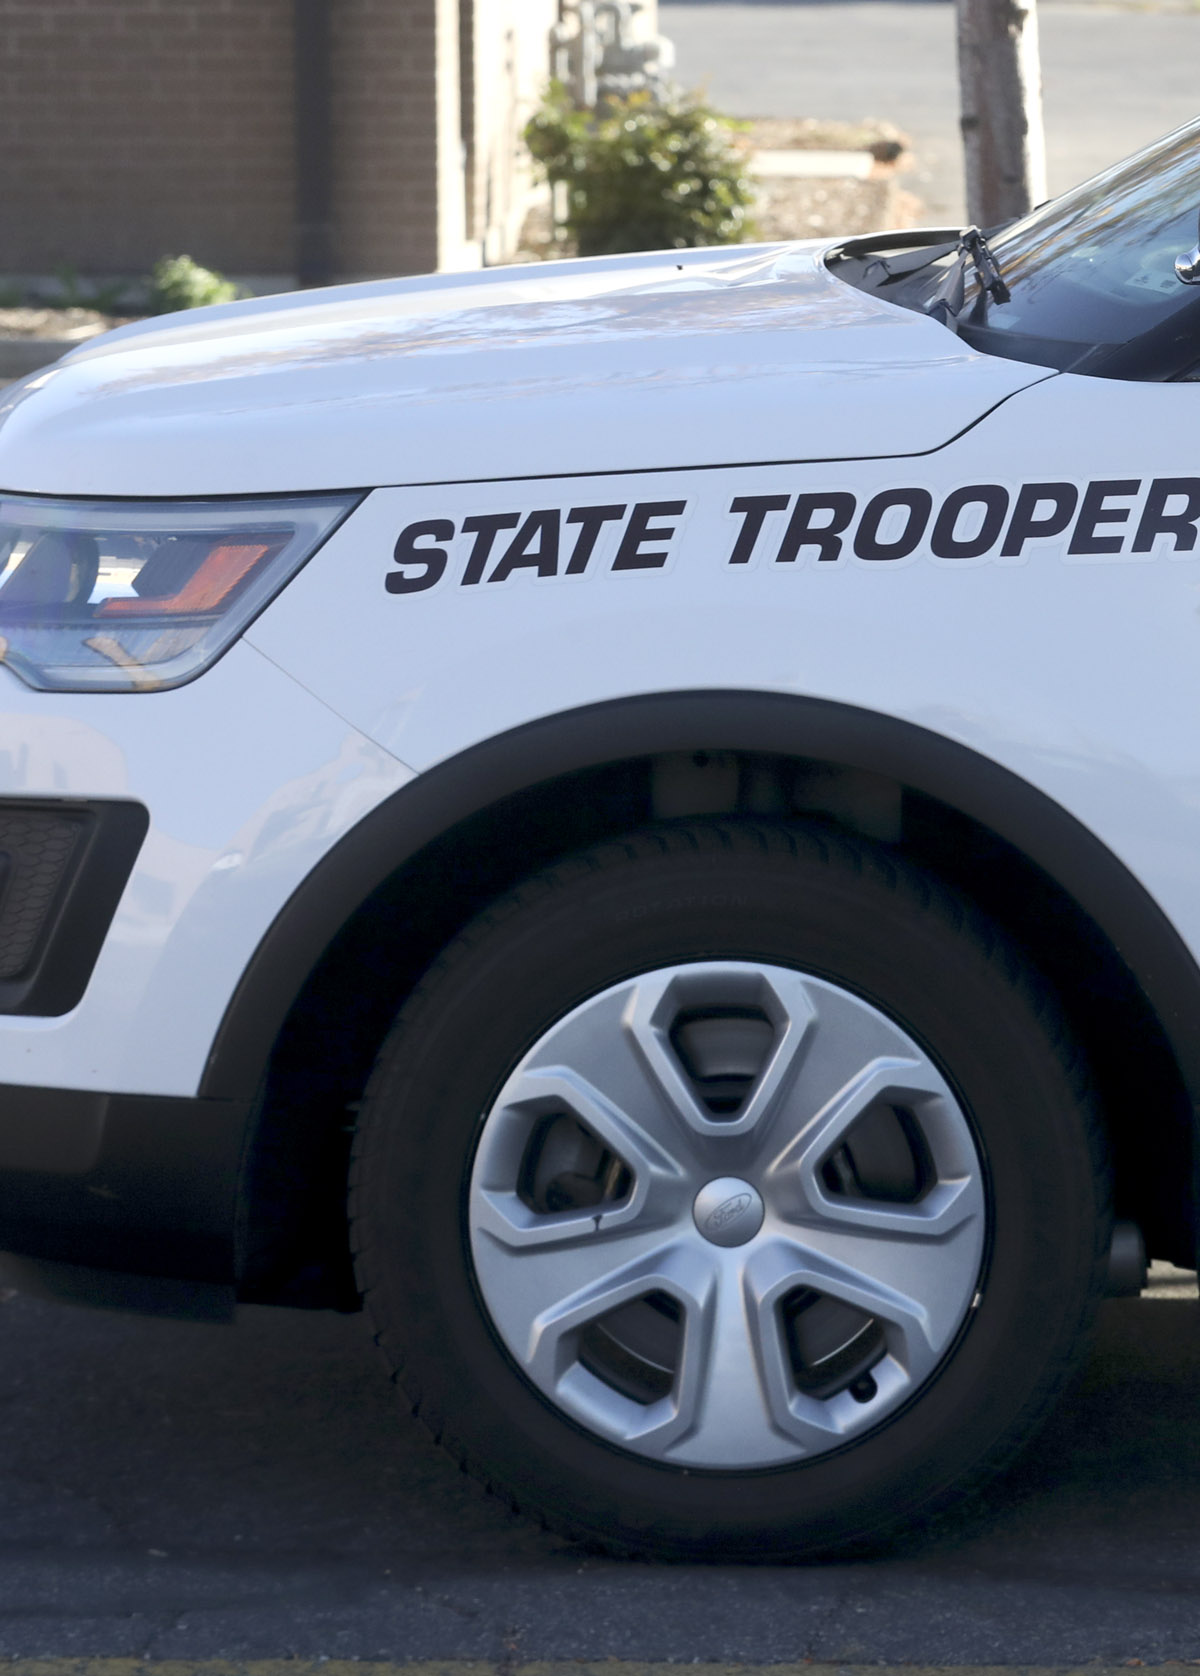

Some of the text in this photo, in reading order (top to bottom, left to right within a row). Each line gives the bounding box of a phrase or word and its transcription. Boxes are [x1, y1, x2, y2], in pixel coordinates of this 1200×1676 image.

[384, 499, 685, 594] STATE
[615, 894, 749, 923] ROTATION
[712, 1198, 744, 1228] Ford
